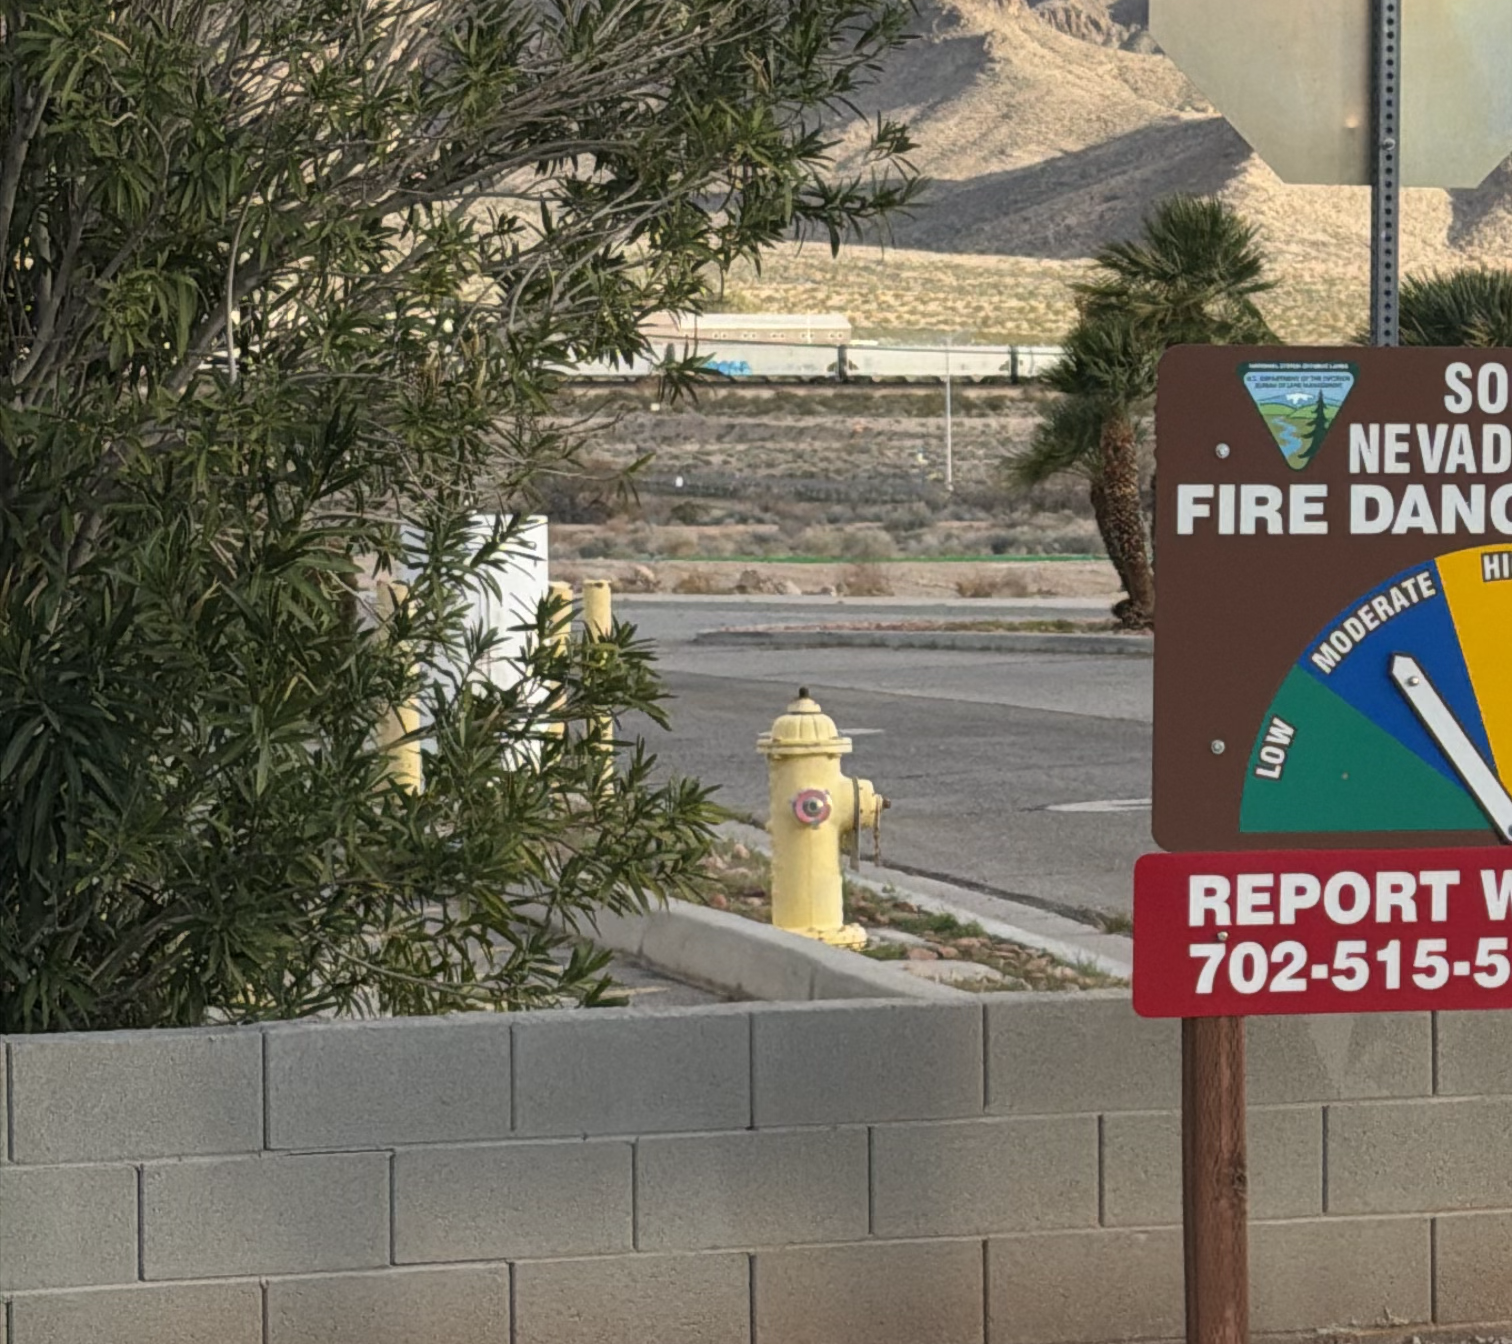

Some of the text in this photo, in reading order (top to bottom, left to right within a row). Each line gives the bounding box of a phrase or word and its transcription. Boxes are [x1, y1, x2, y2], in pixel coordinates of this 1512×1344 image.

[1178, 484, 1327, 534] FIRE
[1312, 572, 1435, 677] MODERATE
[1256, 718, 1294, 778] LOW
[1189, 871, 1460, 926] REPORT
